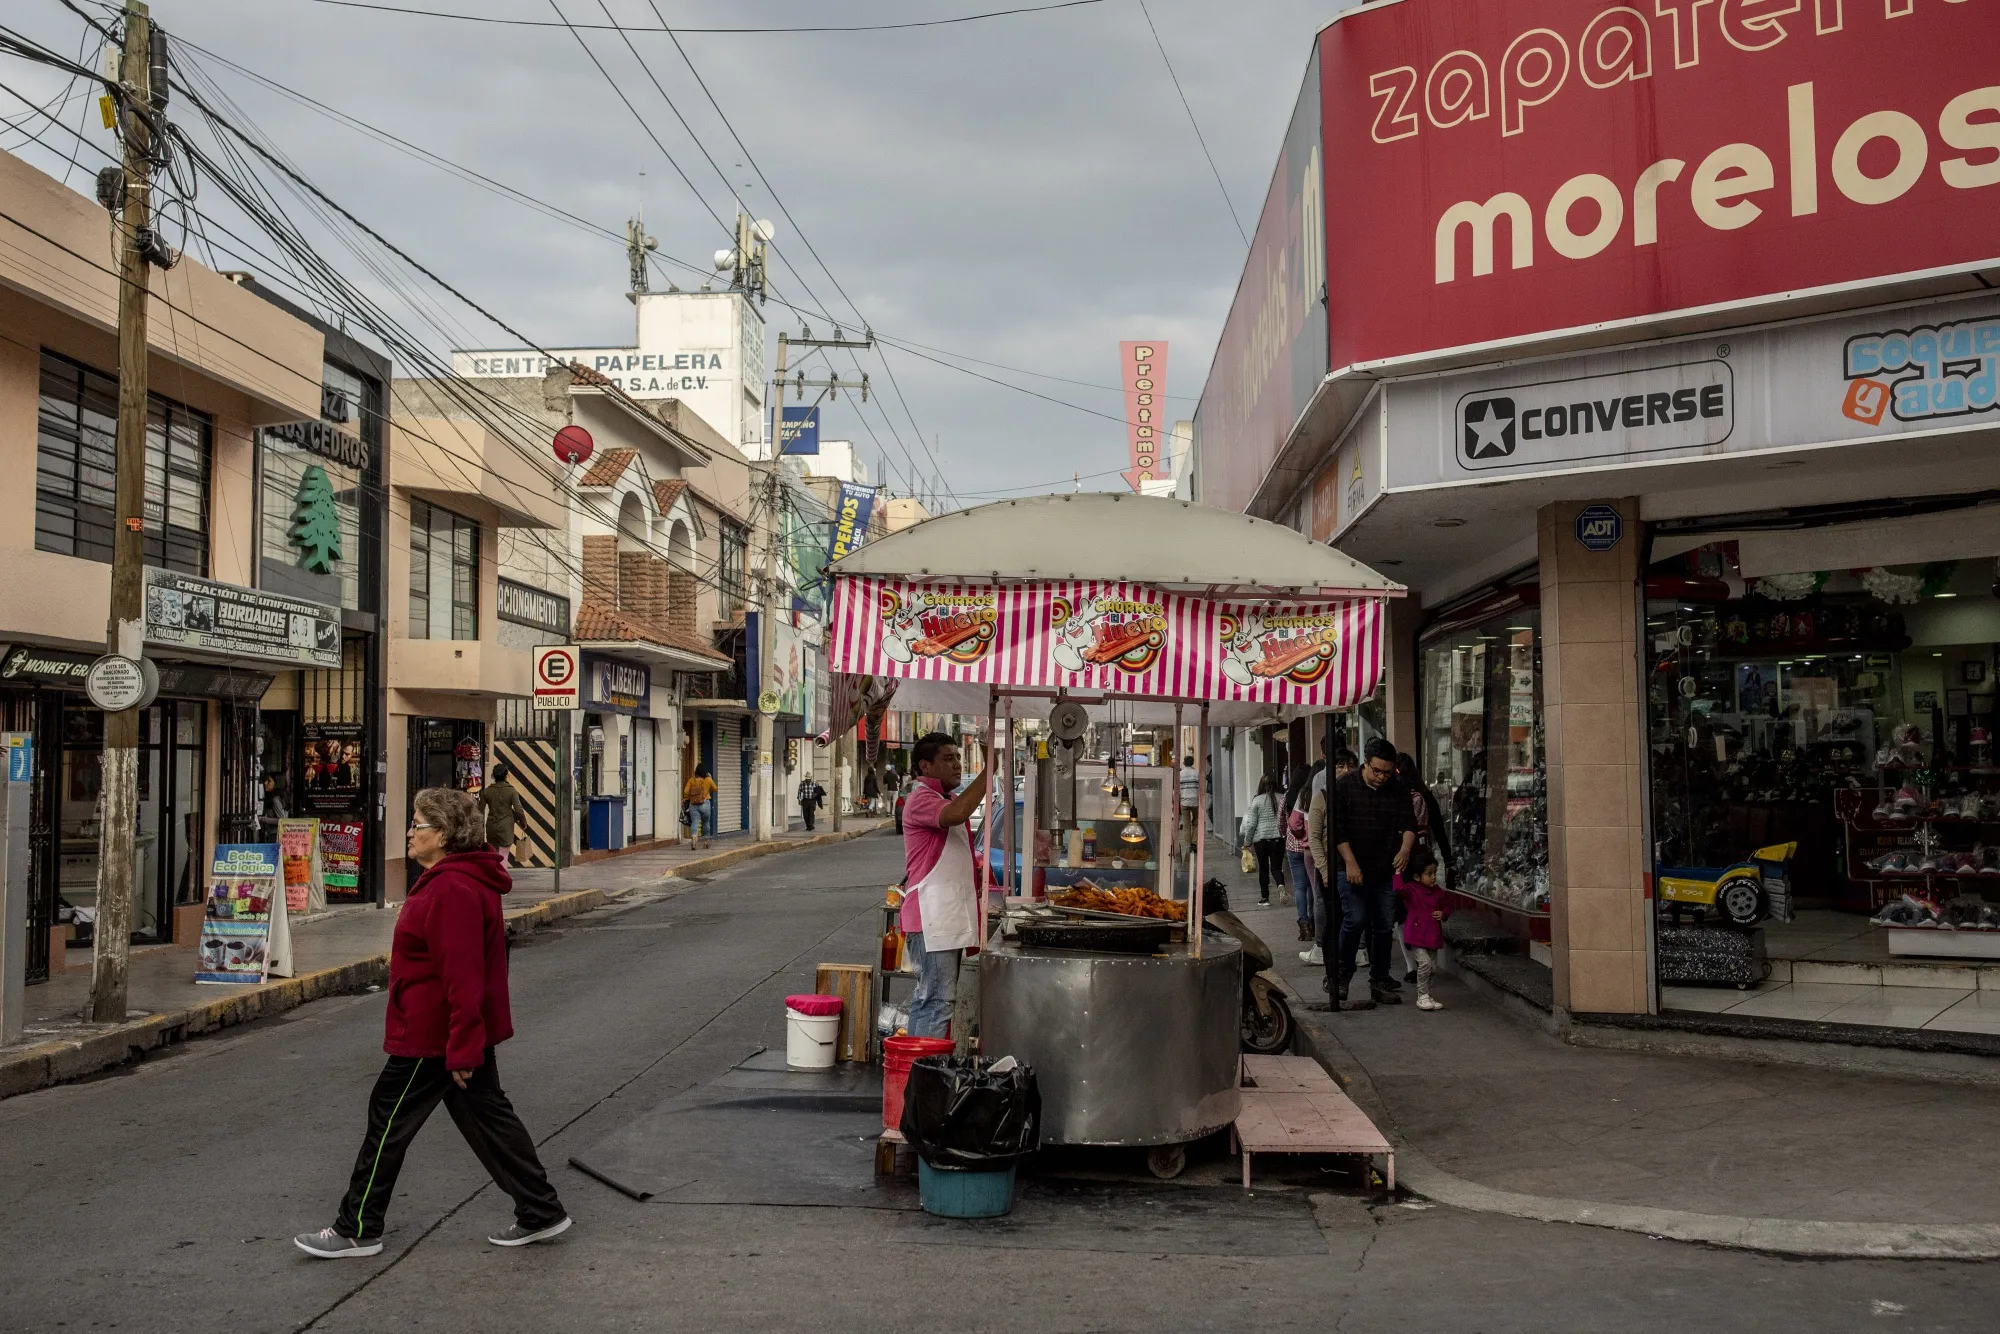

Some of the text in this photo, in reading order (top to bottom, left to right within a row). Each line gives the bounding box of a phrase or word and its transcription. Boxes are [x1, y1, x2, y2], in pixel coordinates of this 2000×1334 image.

[1435, 81, 2000, 284] morelos
[595, 354, 722, 372] PAPELERA
[666, 378, 679, 390] de
[1521, 384, 1723, 440] CONVERSE
[310, 421, 369, 470] CEDROS
[842, 483, 875, 495] RECIBIMOS
[853, 491, 871, 499] AUTO
[1584, 520, 1615, 536] ADT
[176, 579, 320, 617] CREACIÓN DE UNIFORMES
[924, 594, 995, 606] CHURROS
[218, 601, 287, 629] BORDADOS
[1095, 600, 1164, 615] CHURROS
[922, 607, 997, 638] Huevo
[1093, 616, 1168, 643] Huevo
[1262, 616, 1335, 629] CHURROS
[1261, 628, 1337, 659] Huevo
[23, 659, 73, 674] MONKEY
[548, 658, 564, 677] E
[612, 664, 646, 697] LIBERTAD
[537, 696, 570, 707] PUBLICO
[344, 825, 361, 836] DE
[228, 850, 262, 861] Bolsa
